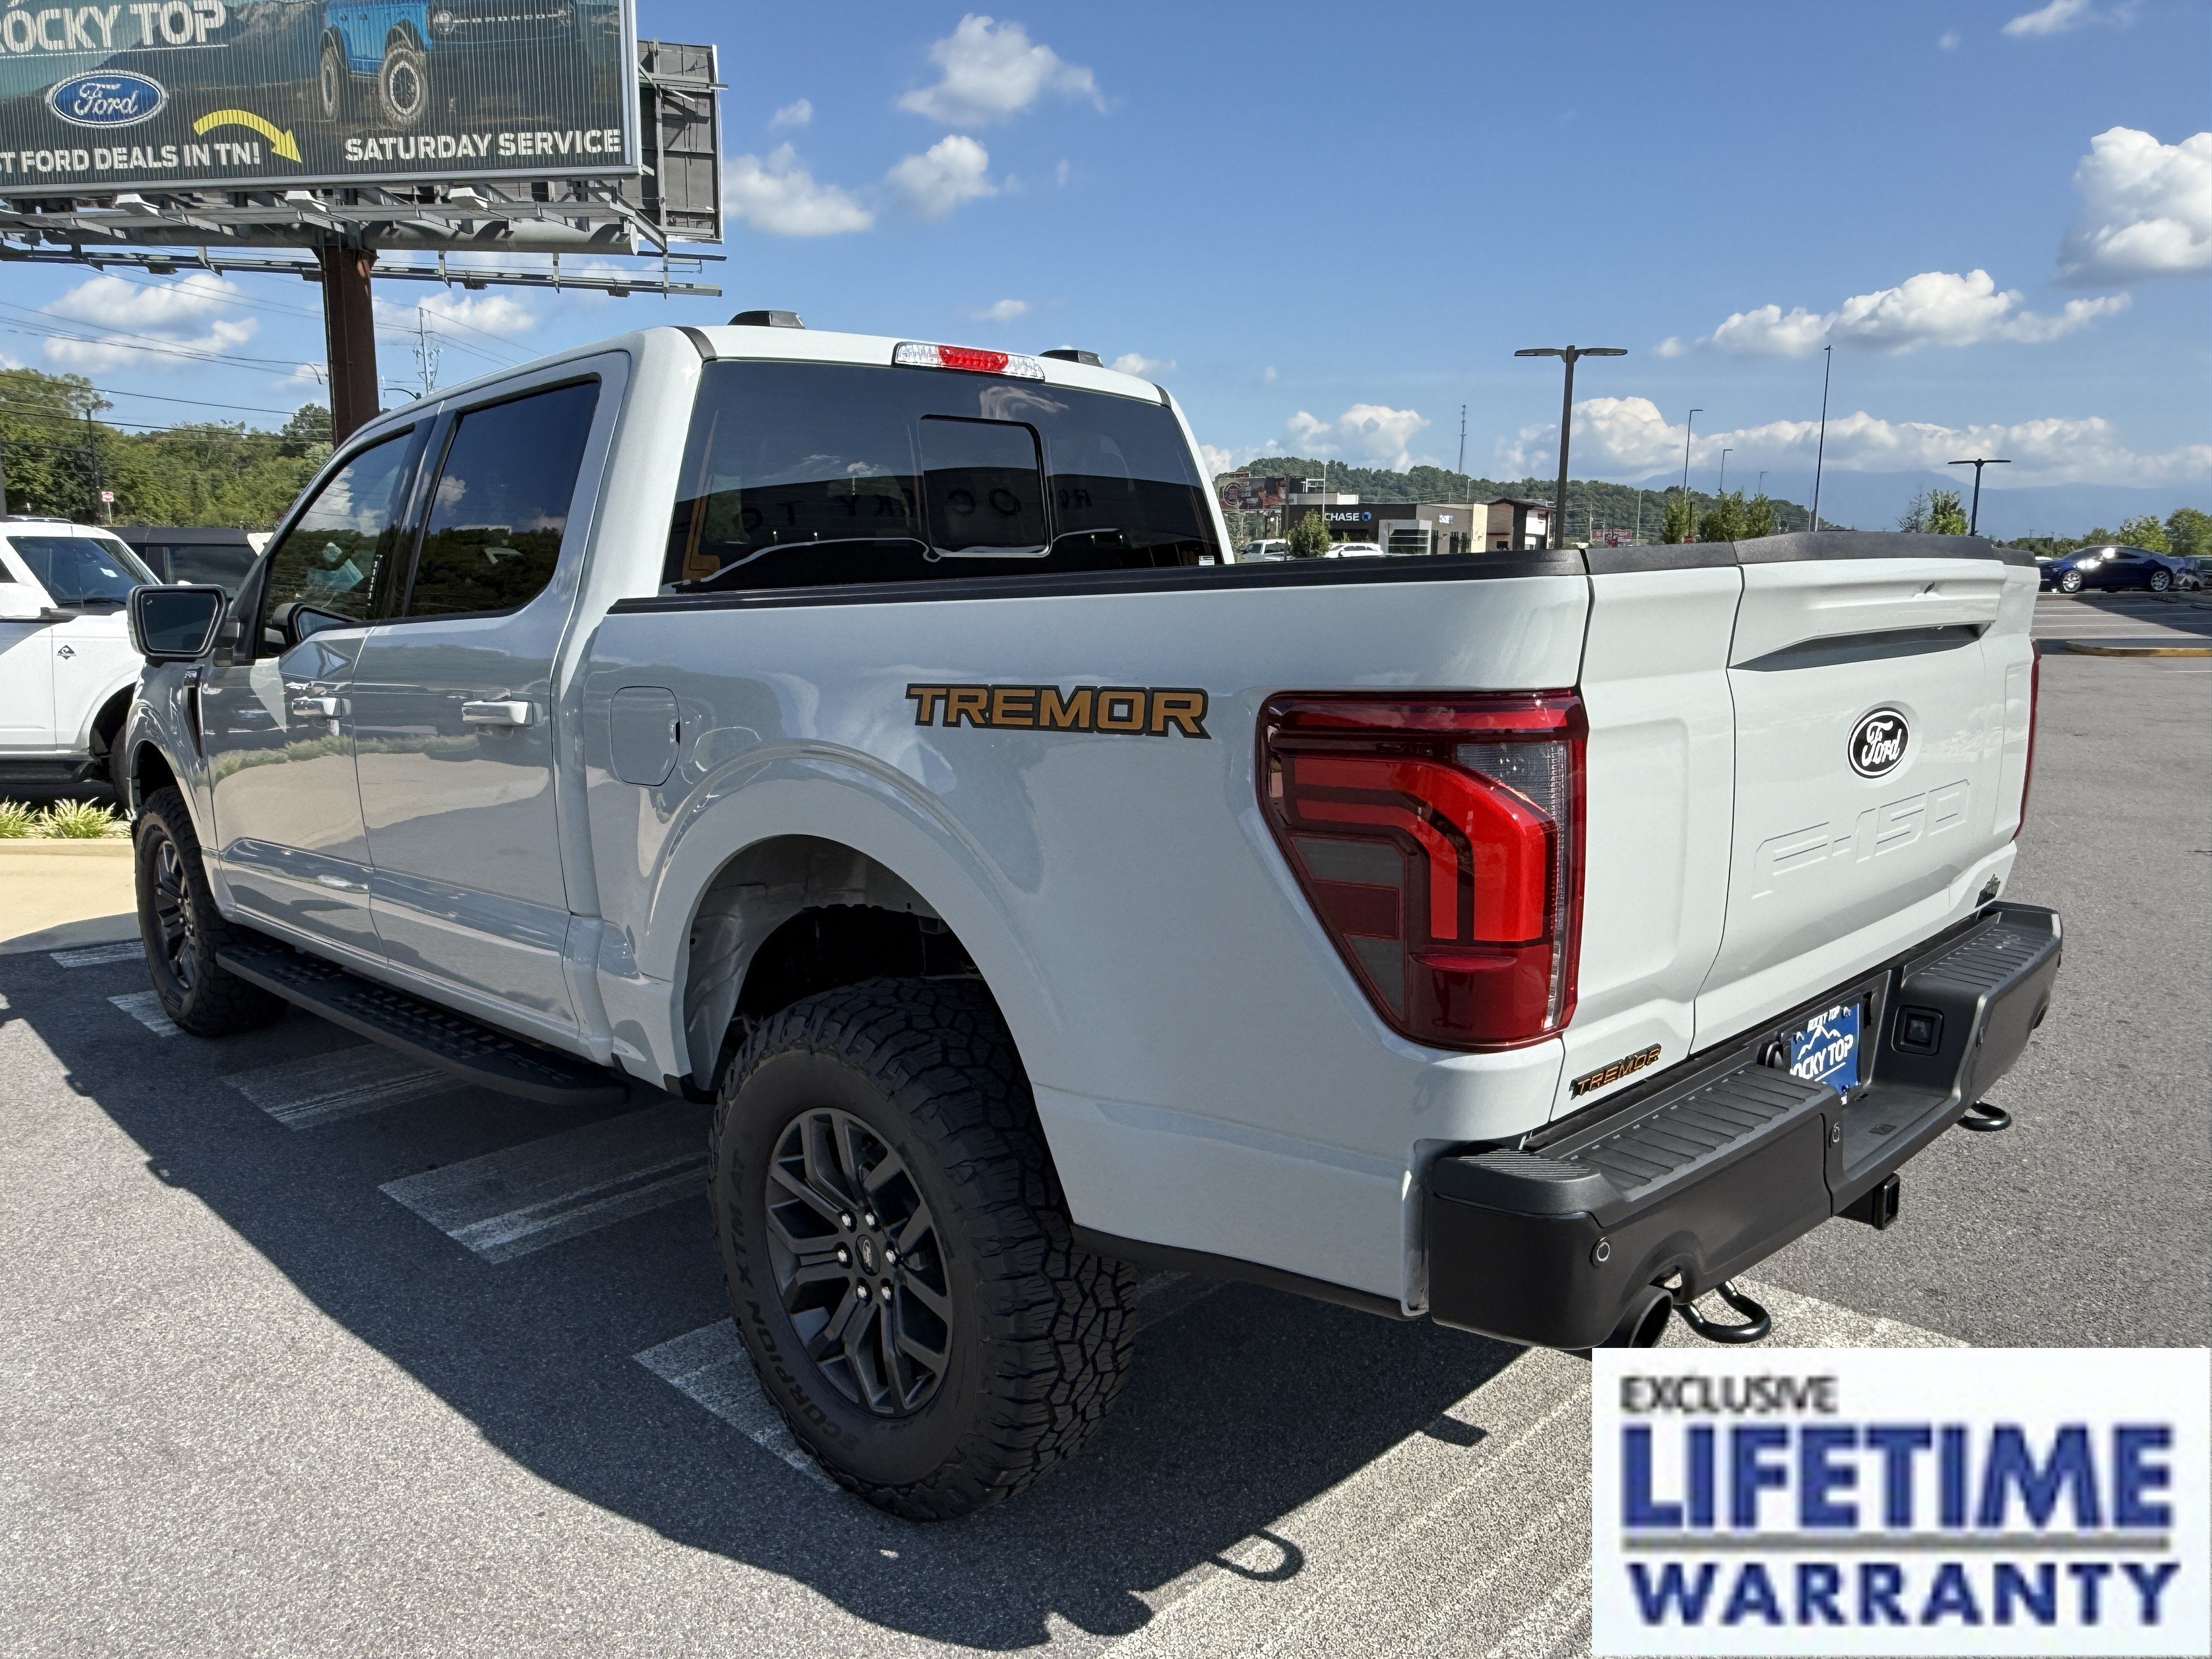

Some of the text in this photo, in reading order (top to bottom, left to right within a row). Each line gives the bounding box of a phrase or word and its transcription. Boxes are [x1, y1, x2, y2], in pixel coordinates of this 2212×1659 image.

[0, 0, 227, 53] OCKY TOP
[74, 82, 139, 116] Ford
[20, 150, 89, 173] FORD
[94, 145, 179, 171] DEALS
[183, 144, 210, 167] IN
[214, 142, 261, 165] TN!
[346, 129, 621, 161] SATURDAY SERVICE
[1323, 512, 1360, 521] CHASE
[905, 684, 1212, 740] TREMOR
[1861, 720, 1902, 767] Ford
[1751, 779, 1970, 900] F-150
[1568, 1043, 1662, 1101] TREMOR
[1790, 1034, 1853, 1080] OCKY TOP
[747, 1299, 860, 1453] SCORPION
